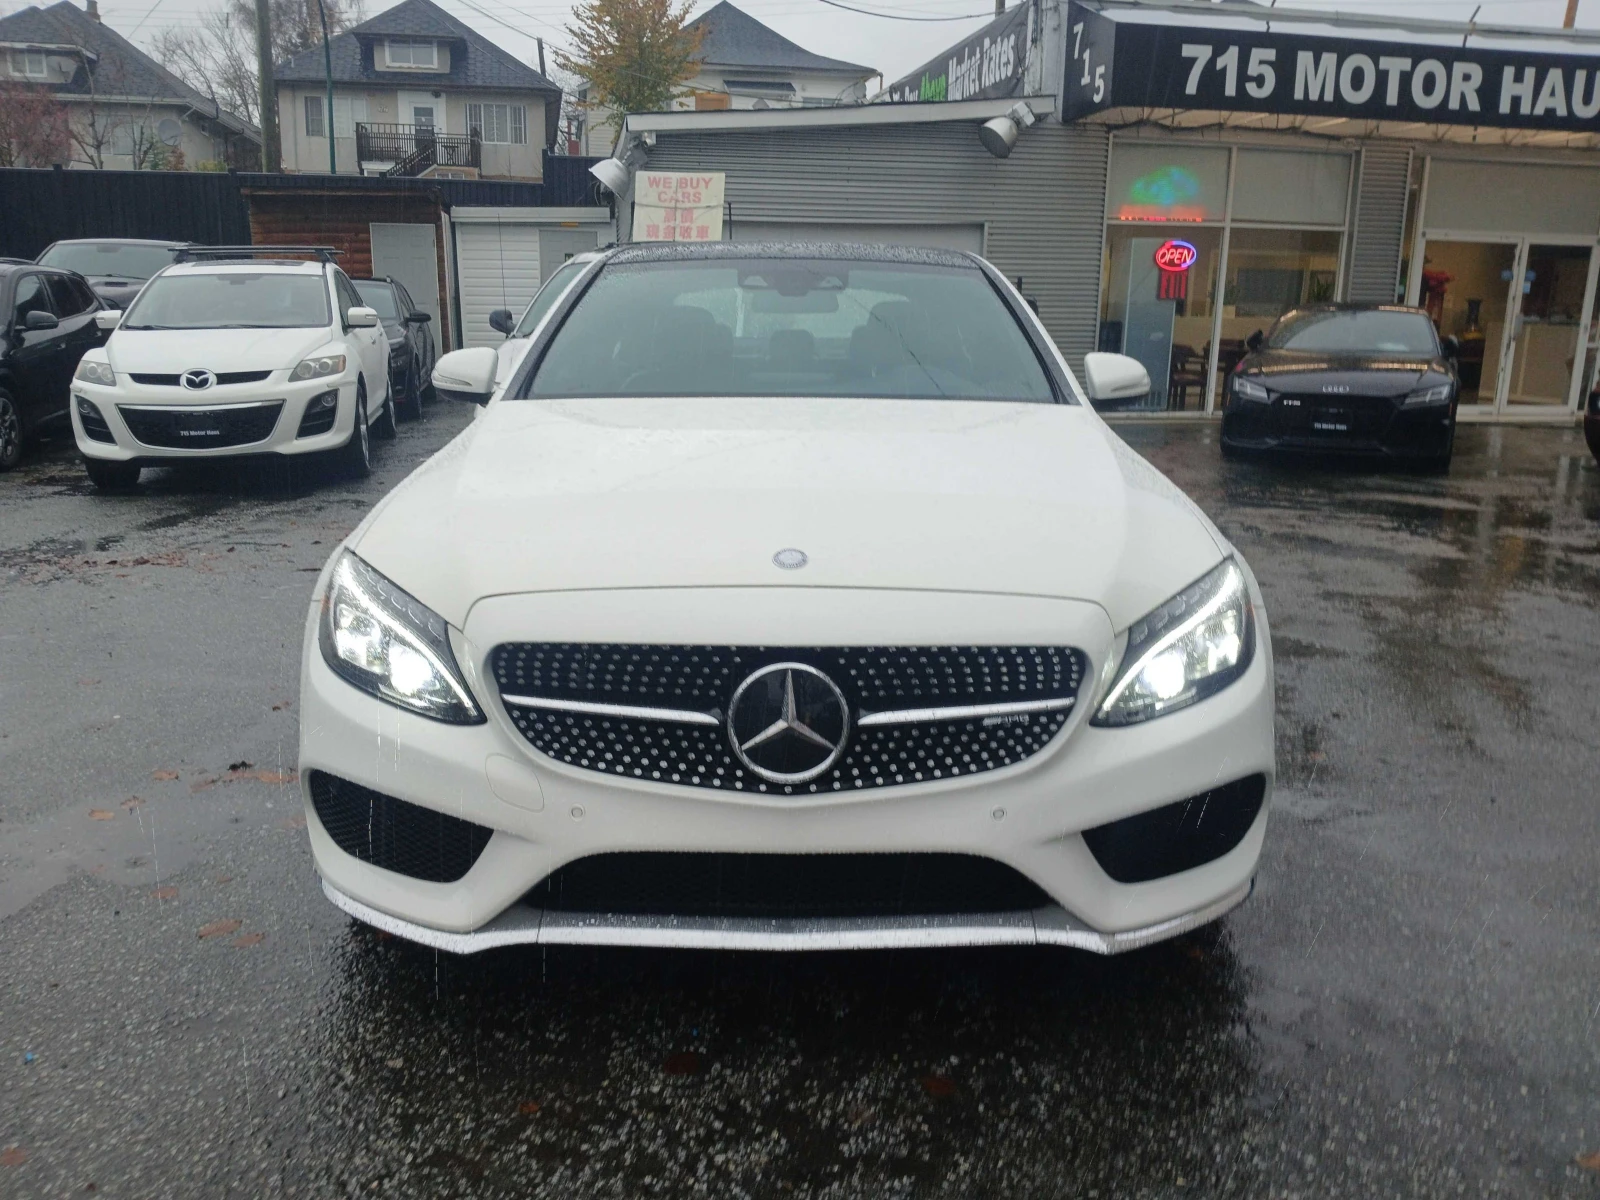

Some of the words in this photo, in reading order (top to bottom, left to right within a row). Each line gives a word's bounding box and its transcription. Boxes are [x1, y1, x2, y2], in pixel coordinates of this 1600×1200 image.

[948, 46, 981, 102] Market
[982, 33, 1015, 89] Rates
[1073, 21, 1105, 104] 715
[1181, 43, 1277, 99] 715
[1294, 50, 1481, 112] MOTOR
[647, 175, 673, 189] WE
[679, 176, 713, 190] BUY
[657, 190, 702, 204] CARS
[1158, 248, 1193, 264] OPEN
